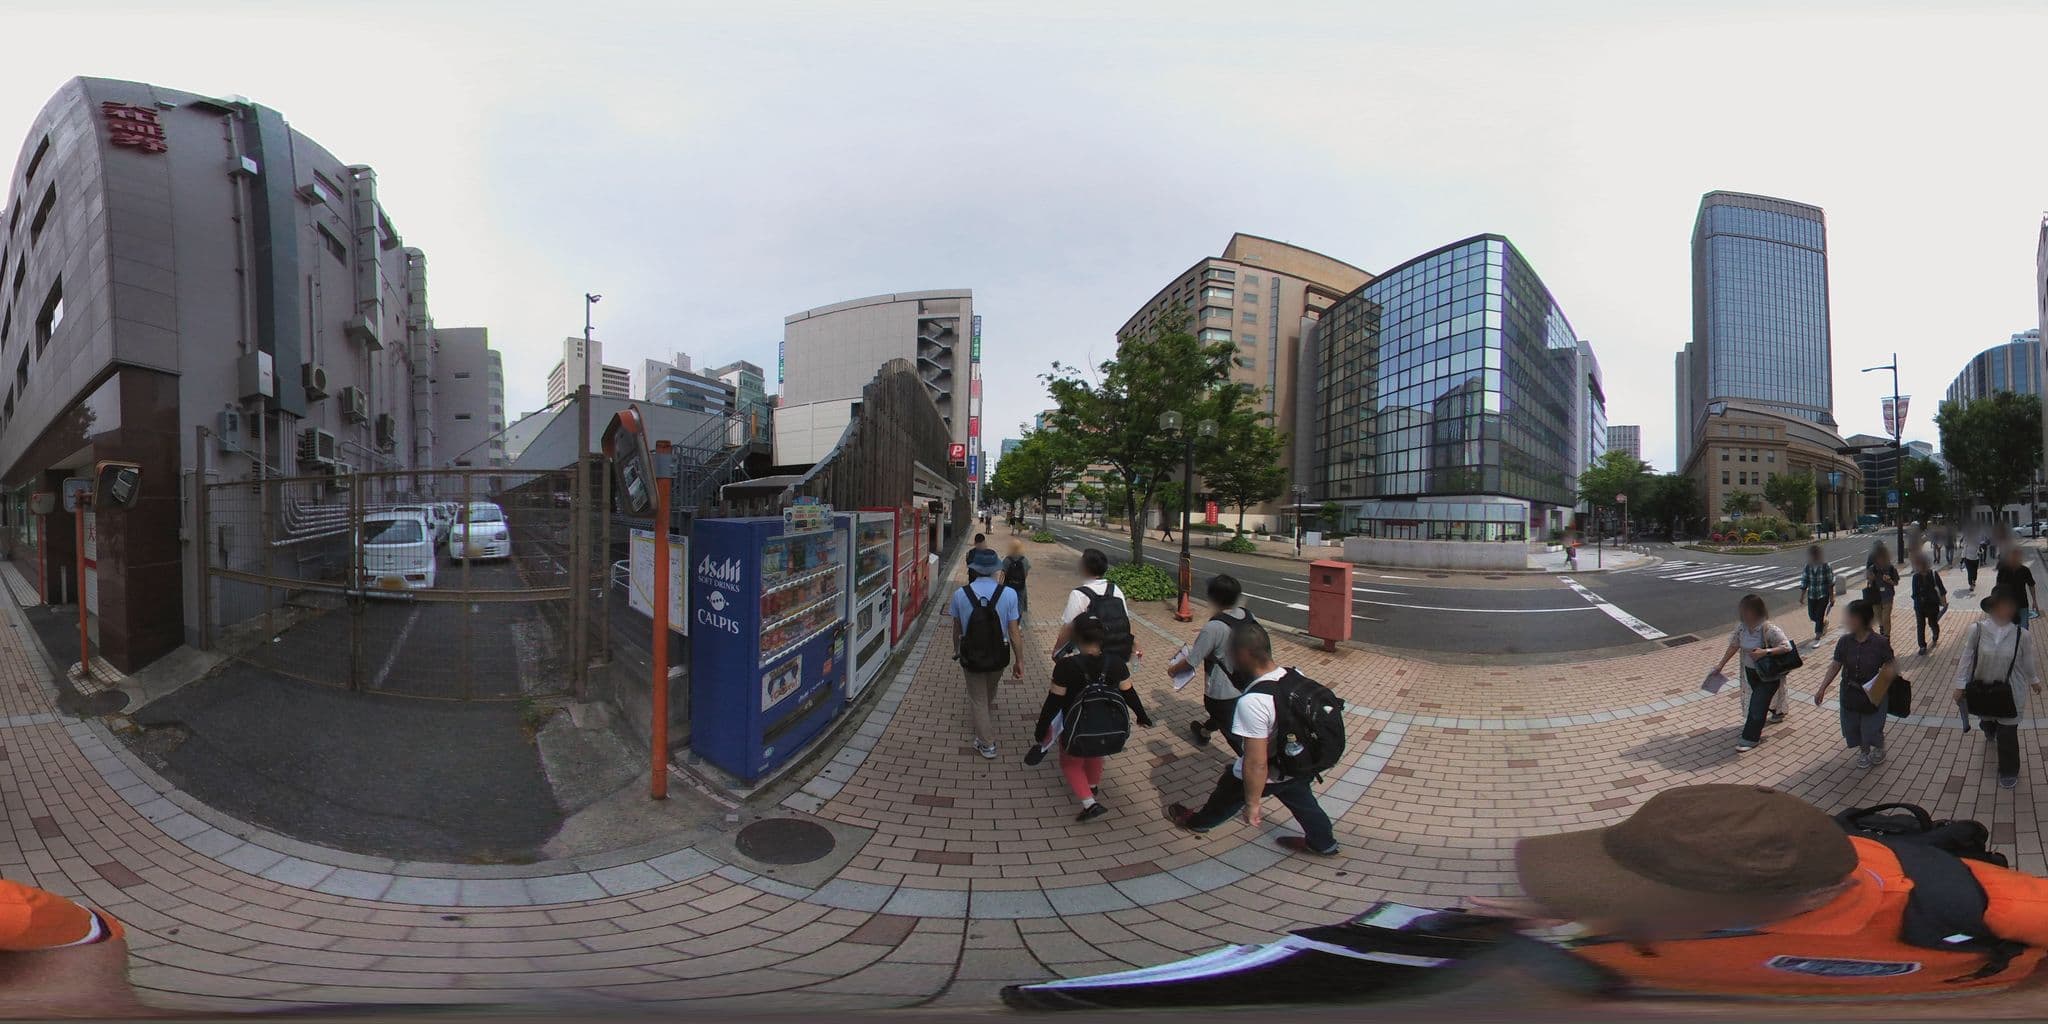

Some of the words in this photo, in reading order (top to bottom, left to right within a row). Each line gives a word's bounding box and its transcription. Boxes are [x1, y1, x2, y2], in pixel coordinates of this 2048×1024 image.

[951, 445, 963, 456] P
[699, 554, 741, 583] Asahi
[698, 575, 713, 586] SOFT
[714, 580, 740, 593] DRINKS
[698, 608, 740, 634] CALPIS
